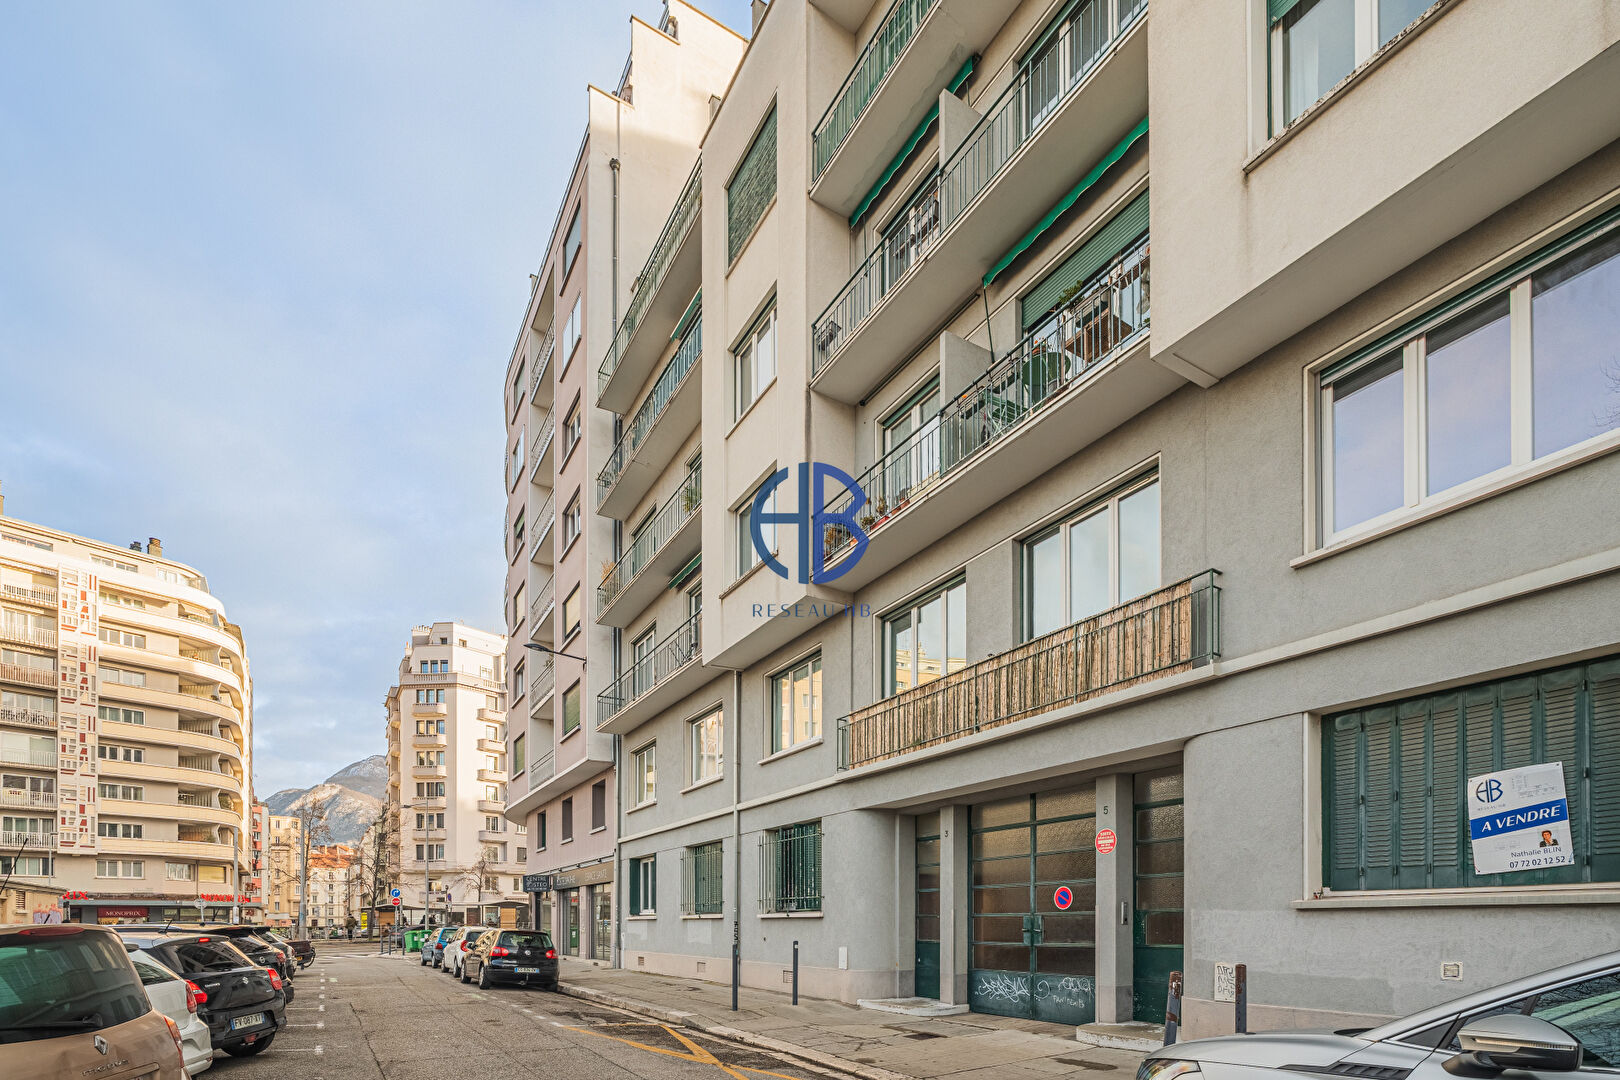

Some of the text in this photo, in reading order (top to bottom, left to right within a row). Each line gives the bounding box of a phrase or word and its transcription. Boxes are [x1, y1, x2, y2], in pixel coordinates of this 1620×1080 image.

[1103, 805, 1109, 815] 5
[1481, 805, 1561, 832] A VENDRE
[944, 830, 949, 838] 3
[1511, 846, 1562, 858] Nathalie BLIN
[1521, 859, 1531, 867] 72
[1532, 858, 1542, 866] 02
[1544, 857, 1553, 865] 12
